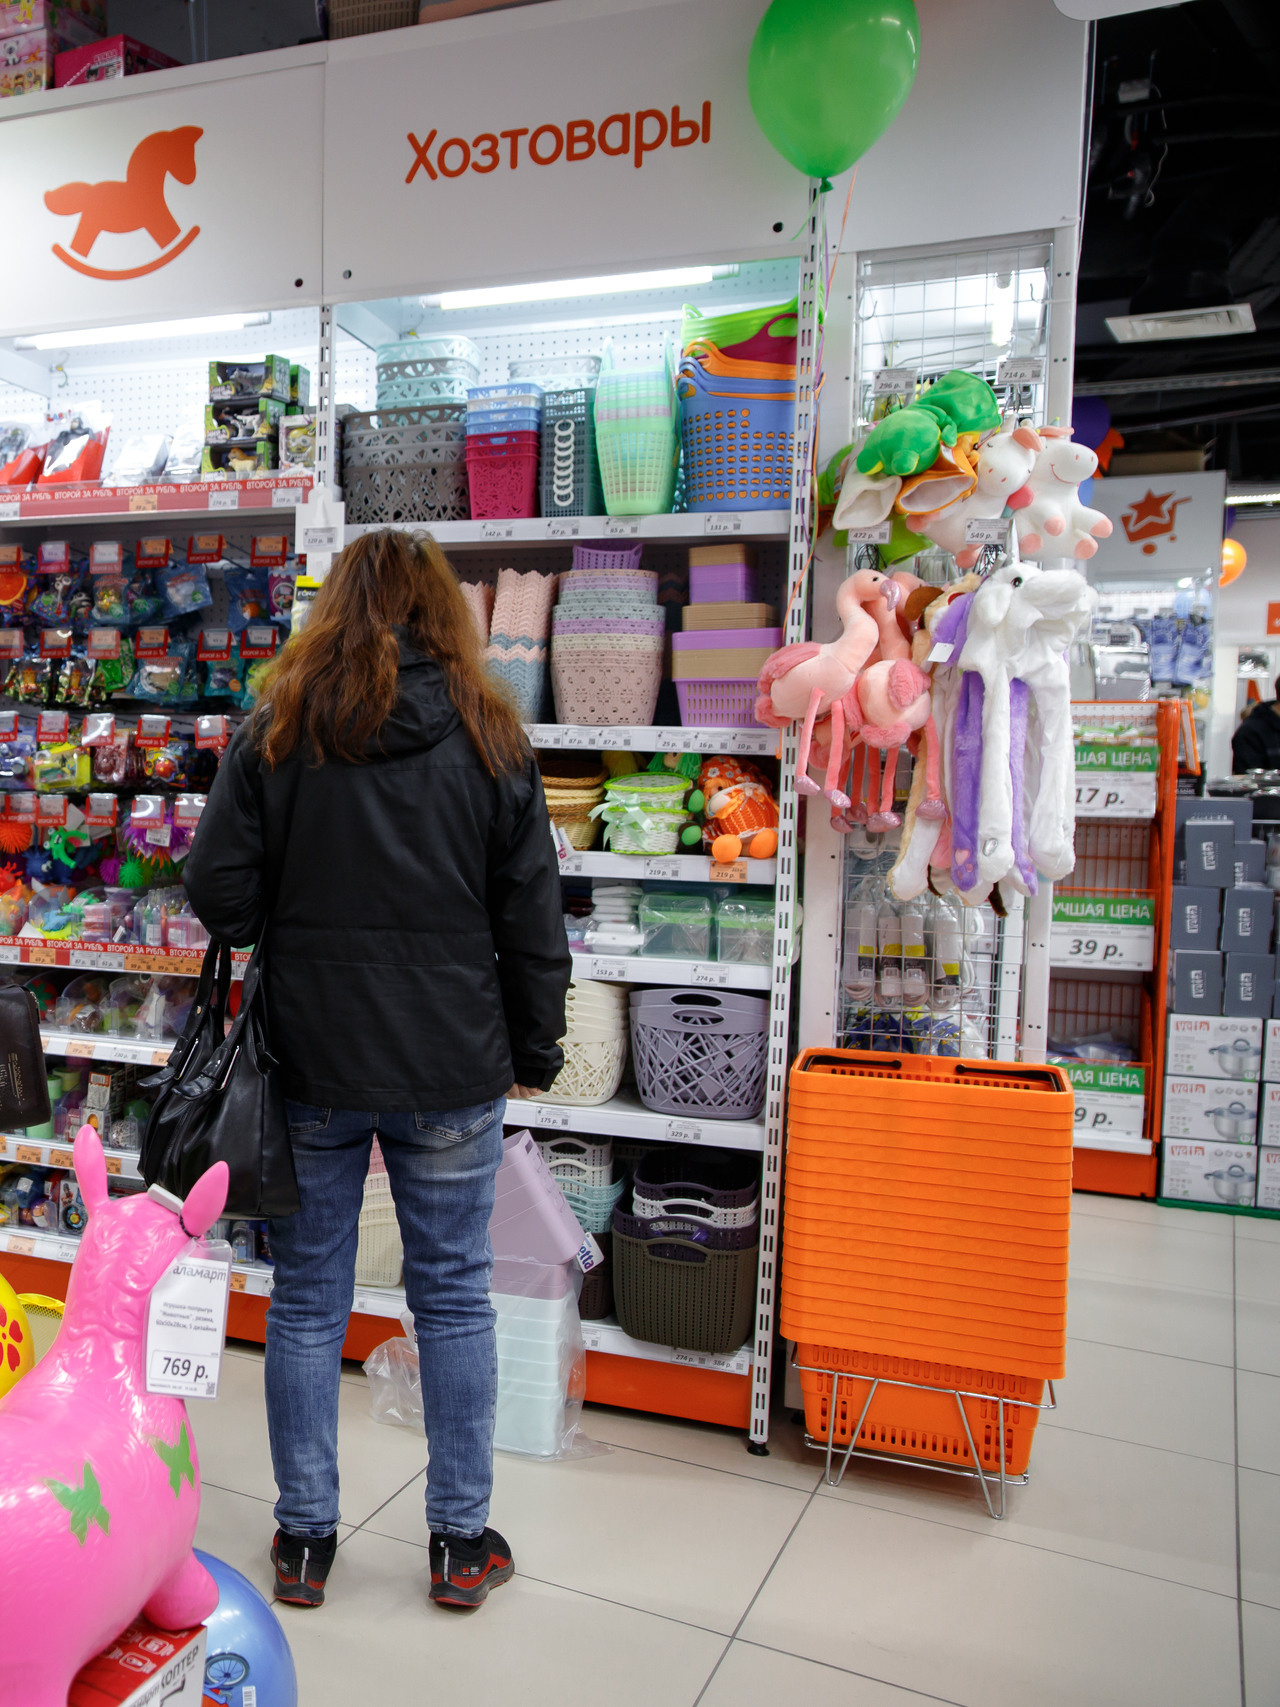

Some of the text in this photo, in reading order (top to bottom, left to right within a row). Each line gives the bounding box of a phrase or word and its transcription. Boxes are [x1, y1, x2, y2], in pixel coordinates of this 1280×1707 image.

[405, 101, 712, 184] Хозтовары
[54, 487, 81, 500] ВТОРОЙ
[93, 487, 112, 497] РУБЛЬ
[117, 485, 143, 497] ВТОРОЙ
[155, 484, 176, 494] РУБЛЬ
[180, 482, 209, 494] ВТОРОЙ
[221, 481, 242, 490] РУБЛЬ
[246, 478, 274, 490] ВТОРОЙ
[287, 477, 311, 487] РУБЛЬ
[1111, 751, 1152, 768] ЦЕНА
[1104, 792, 1125, 808] р.
[1109, 904, 1150, 919] ЦЕНА
[25, 938, 43, 947] РУБЛЬ
[47, 938, 71, 949] ВТОРОЙ
[84, 942, 103, 951] РУБЛЬ
[108, 943, 133, 954] ВТОРОЙ
[146, 946, 166, 956] РУБЛЬ
[170, 947, 197, 958] ВТОРОЙ
[1103, 943, 1123, 960] р.
[1099, 1070, 1140, 1088] ЦЕНА
[1092, 1110, 1113, 1127] р.
[173, 1264, 226, 1284] аламарт
[162, 1357, 209, 1383] 769 р.
